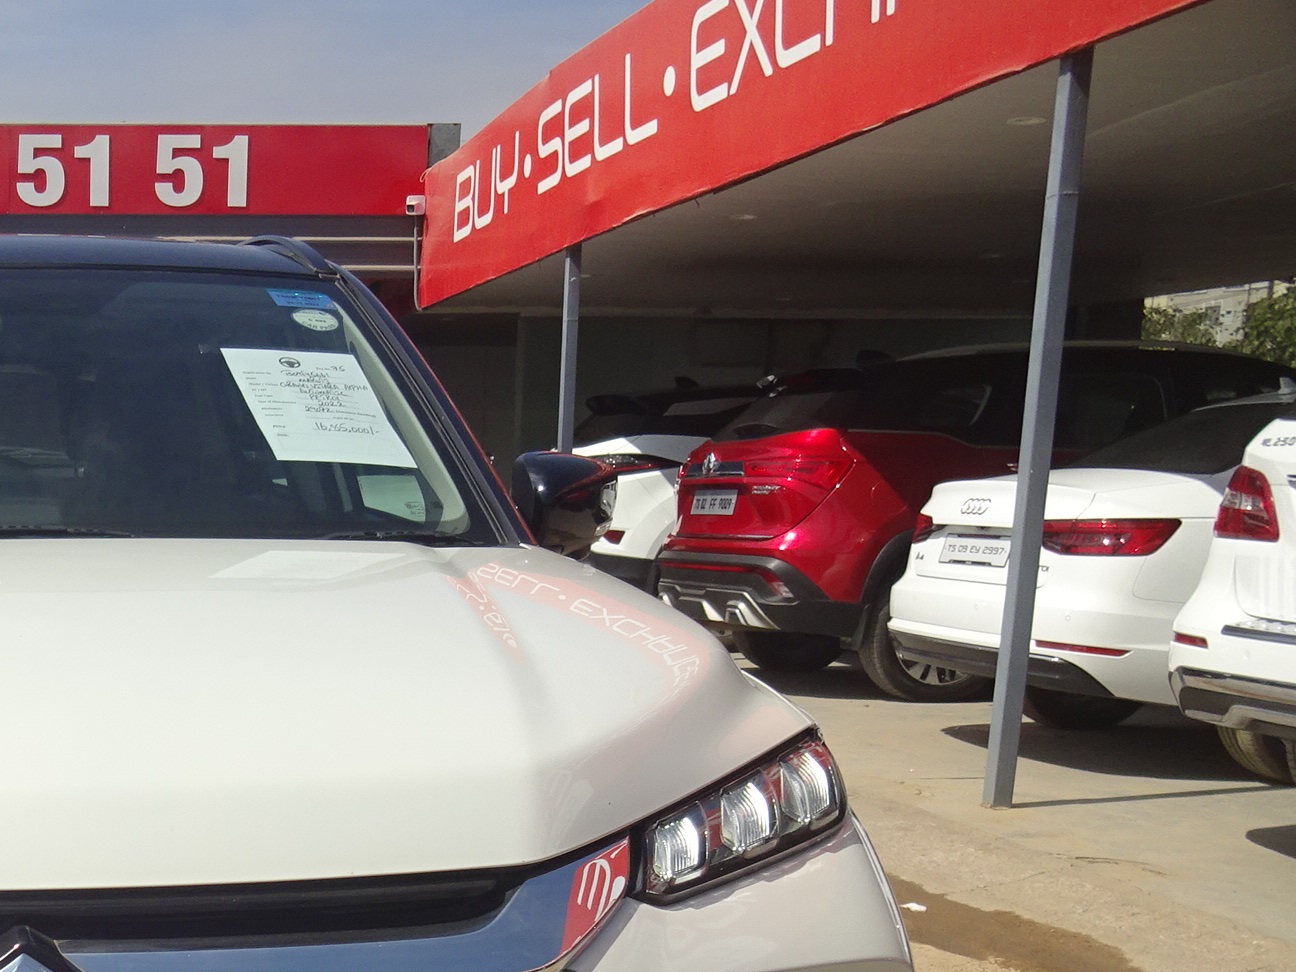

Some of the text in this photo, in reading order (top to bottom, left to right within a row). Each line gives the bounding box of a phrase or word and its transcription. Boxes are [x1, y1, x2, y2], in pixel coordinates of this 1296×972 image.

[15, 133, 109, 208] 51
[153, 133, 249, 208] 51
[454, 131, 519, 243] BUY
[537, 53, 657, 195] SELL
[947, 544, 957, 553] TS
[958, 544, 968, 553] 09
[982, 546, 1005, 556] 2997
